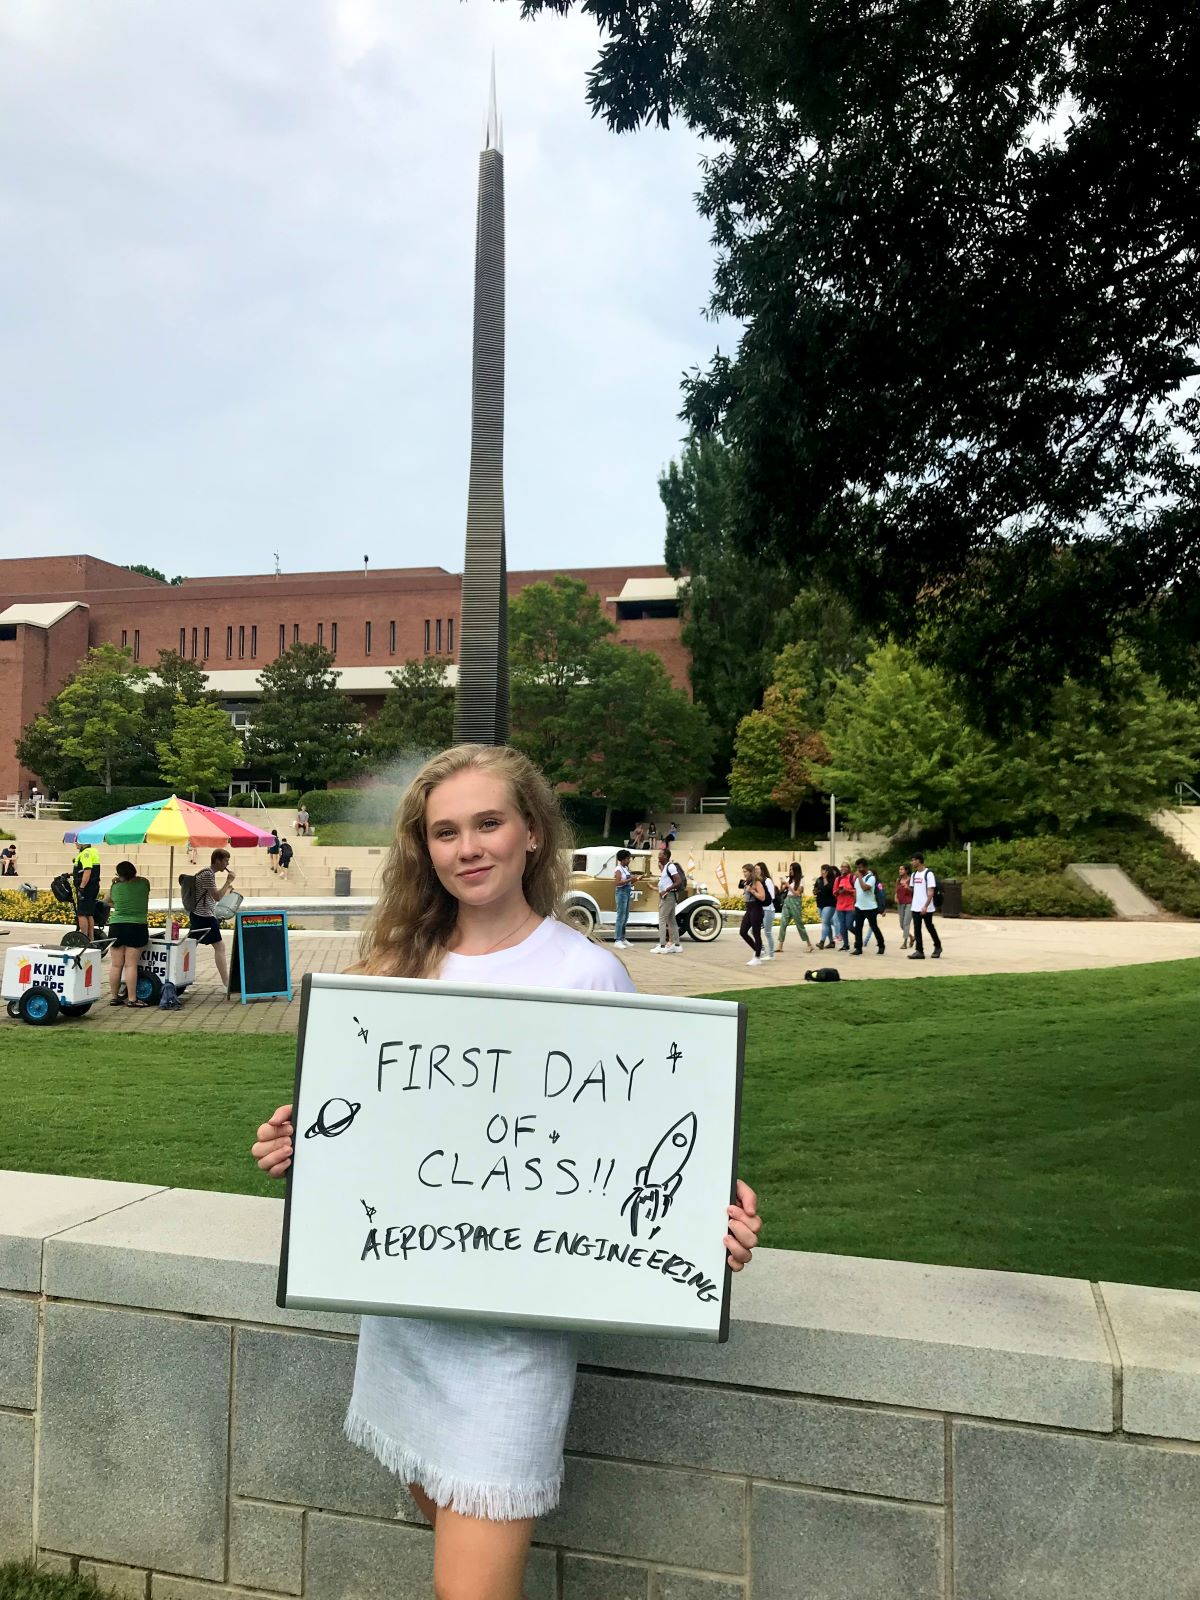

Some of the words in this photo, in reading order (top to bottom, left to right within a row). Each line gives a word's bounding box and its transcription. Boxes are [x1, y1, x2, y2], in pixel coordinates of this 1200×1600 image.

[33, 963, 65, 976] KING
[378, 1041, 513, 1094] FIRST
[544, 1051, 645, 1104] DAY
[487, 1114, 537, 1149] OF
[418, 1150, 617, 1196] CLASS!!
[361, 1223, 522, 1262] AEROSPACE
[533, 1229, 718, 1303] ENGINEERING
